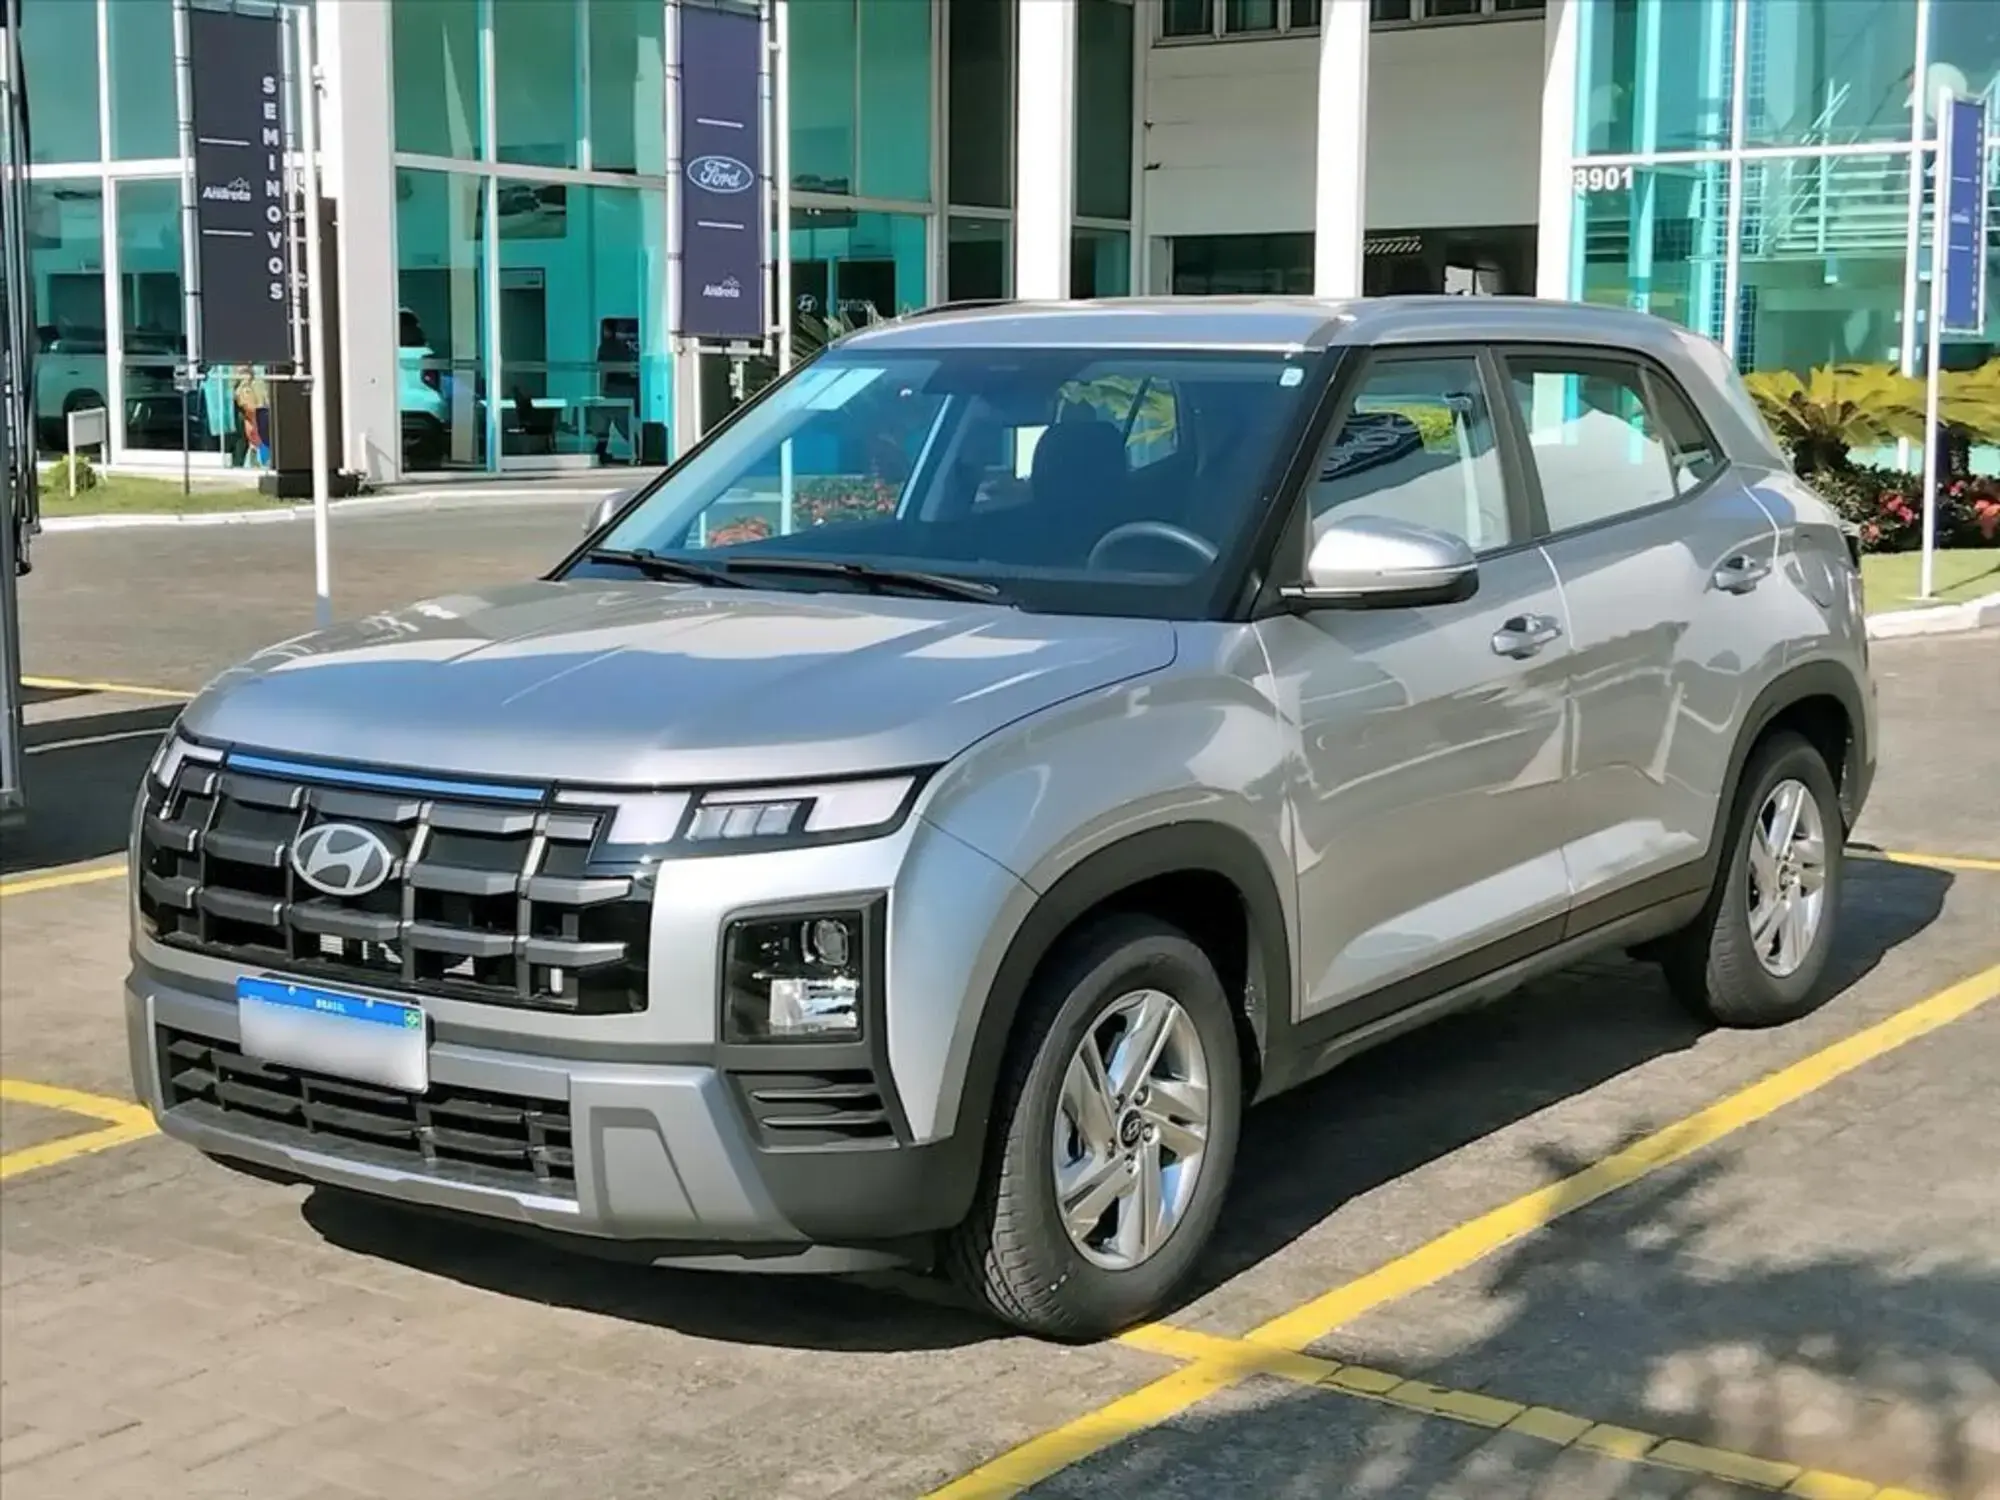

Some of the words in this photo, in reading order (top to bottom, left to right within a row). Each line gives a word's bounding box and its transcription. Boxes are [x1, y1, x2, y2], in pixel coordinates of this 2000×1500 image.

[700, 159, 742, 189] Ford
[1574, 166, 1634, 191] 3901
[262, 76, 283, 300] SEMINOVOS
[315, 998, 346, 1012] BRASIL
